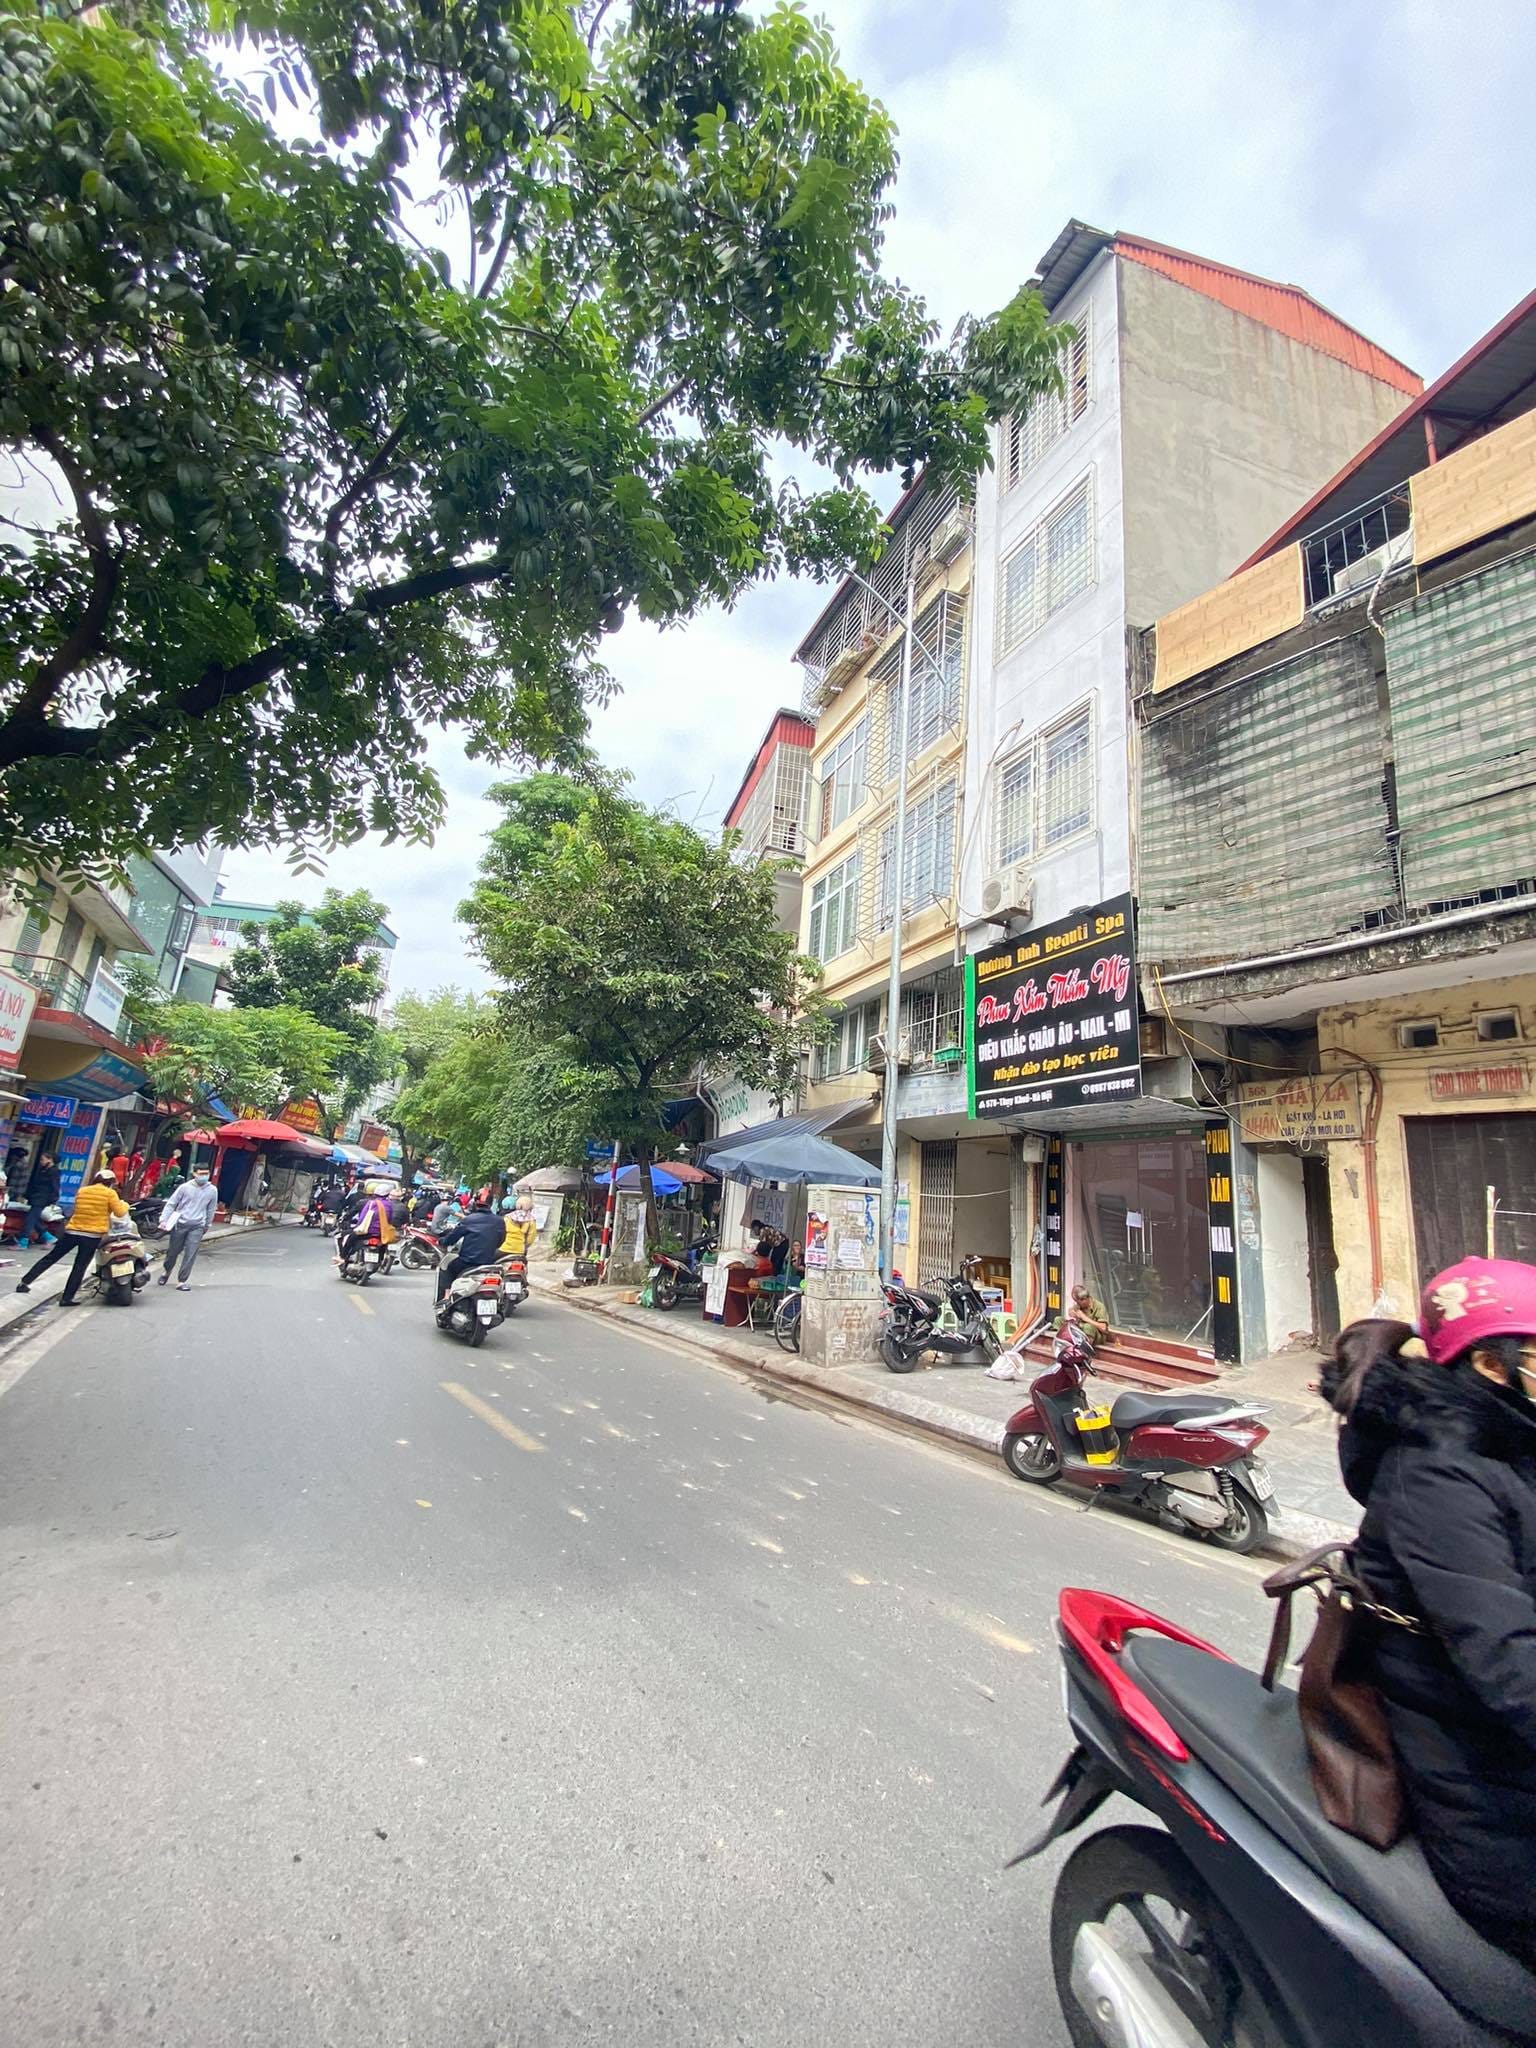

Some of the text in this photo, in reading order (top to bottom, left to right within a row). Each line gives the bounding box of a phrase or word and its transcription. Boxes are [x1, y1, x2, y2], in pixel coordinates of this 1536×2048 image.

[1045, 923, 1088, 953] Beauti
[1095, 912, 1124, 934] Spa
[977, 995, 1010, 1028] Phun
[1090, 954, 1130, 1002] Mỹ
[1000, 1029, 1026, 1058] KHẮC
[1028, 1025, 1056, 1052] CHÂU
[1058, 1021, 1073, 1045] ÂU
[1080, 1015, 1107, 1041] NAIL
[1114, 1009, 1131, 1033] MI
[993, 1044, 1119, 1082] Nhận đào tạo học viên
[1435, 1072, 1454, 1095] CHO
[1206, 1129, 1230, 1154] PHUN
[1210, 1172, 1231, 1202] XĂM
[1211, 1226, 1234, 1252] NAIL
